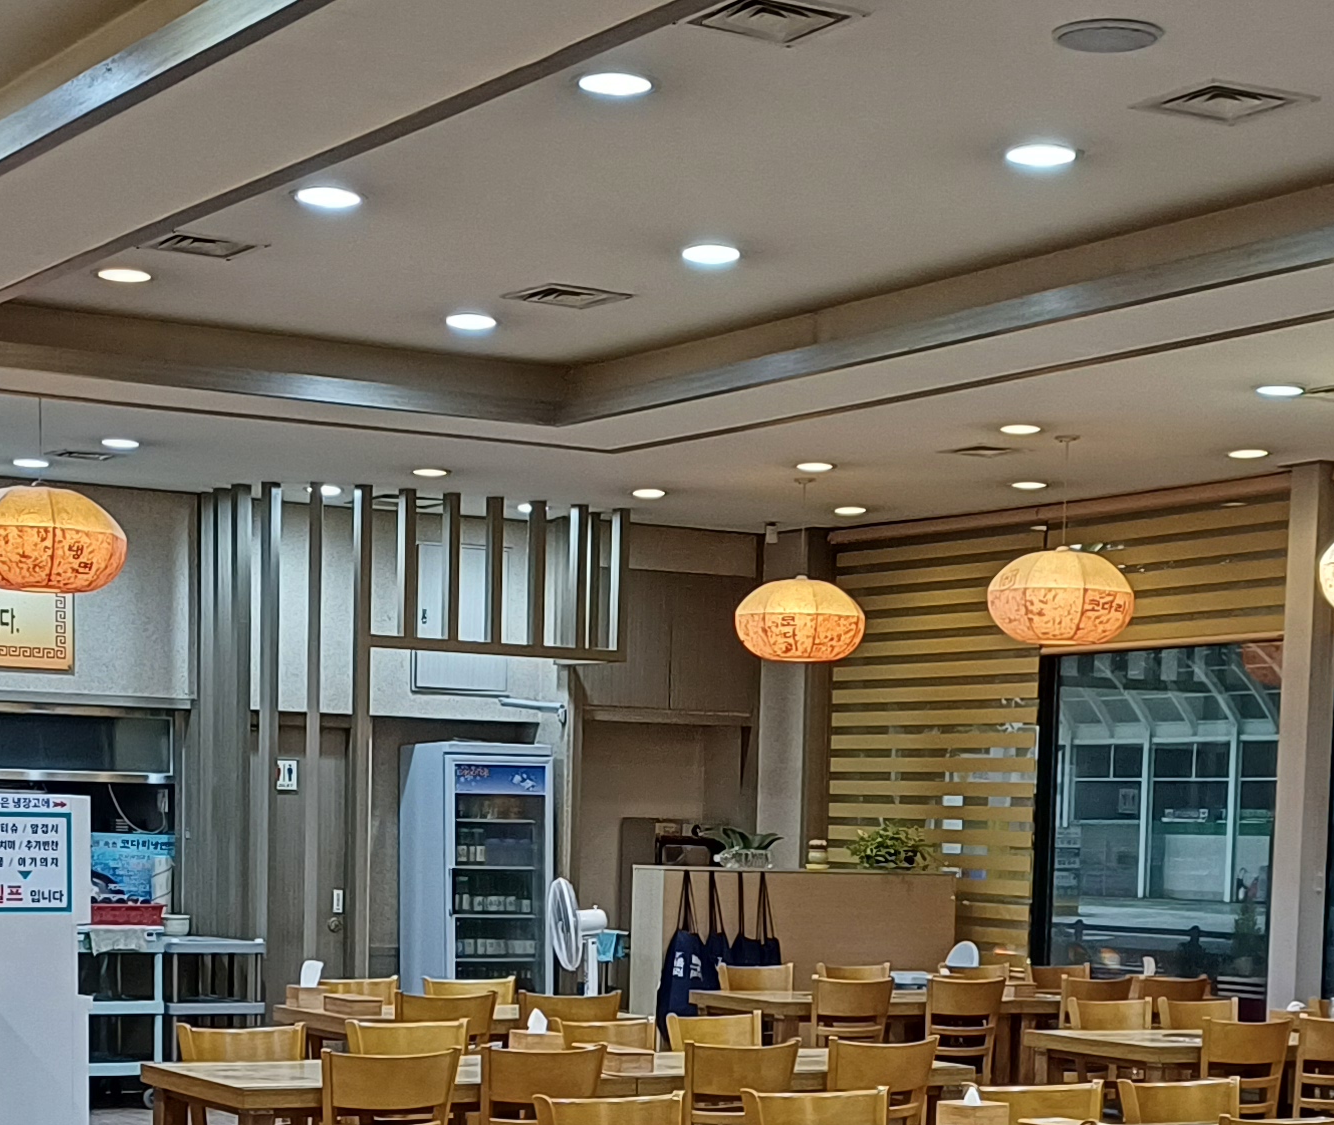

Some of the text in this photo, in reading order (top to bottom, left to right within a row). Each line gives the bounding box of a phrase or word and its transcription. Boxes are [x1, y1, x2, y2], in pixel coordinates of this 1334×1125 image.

[1084, 599, 1126, 614] 코다리
[12, 797, 50, 809] 냉장고에
[30, 889, 65, 904] 입니다
